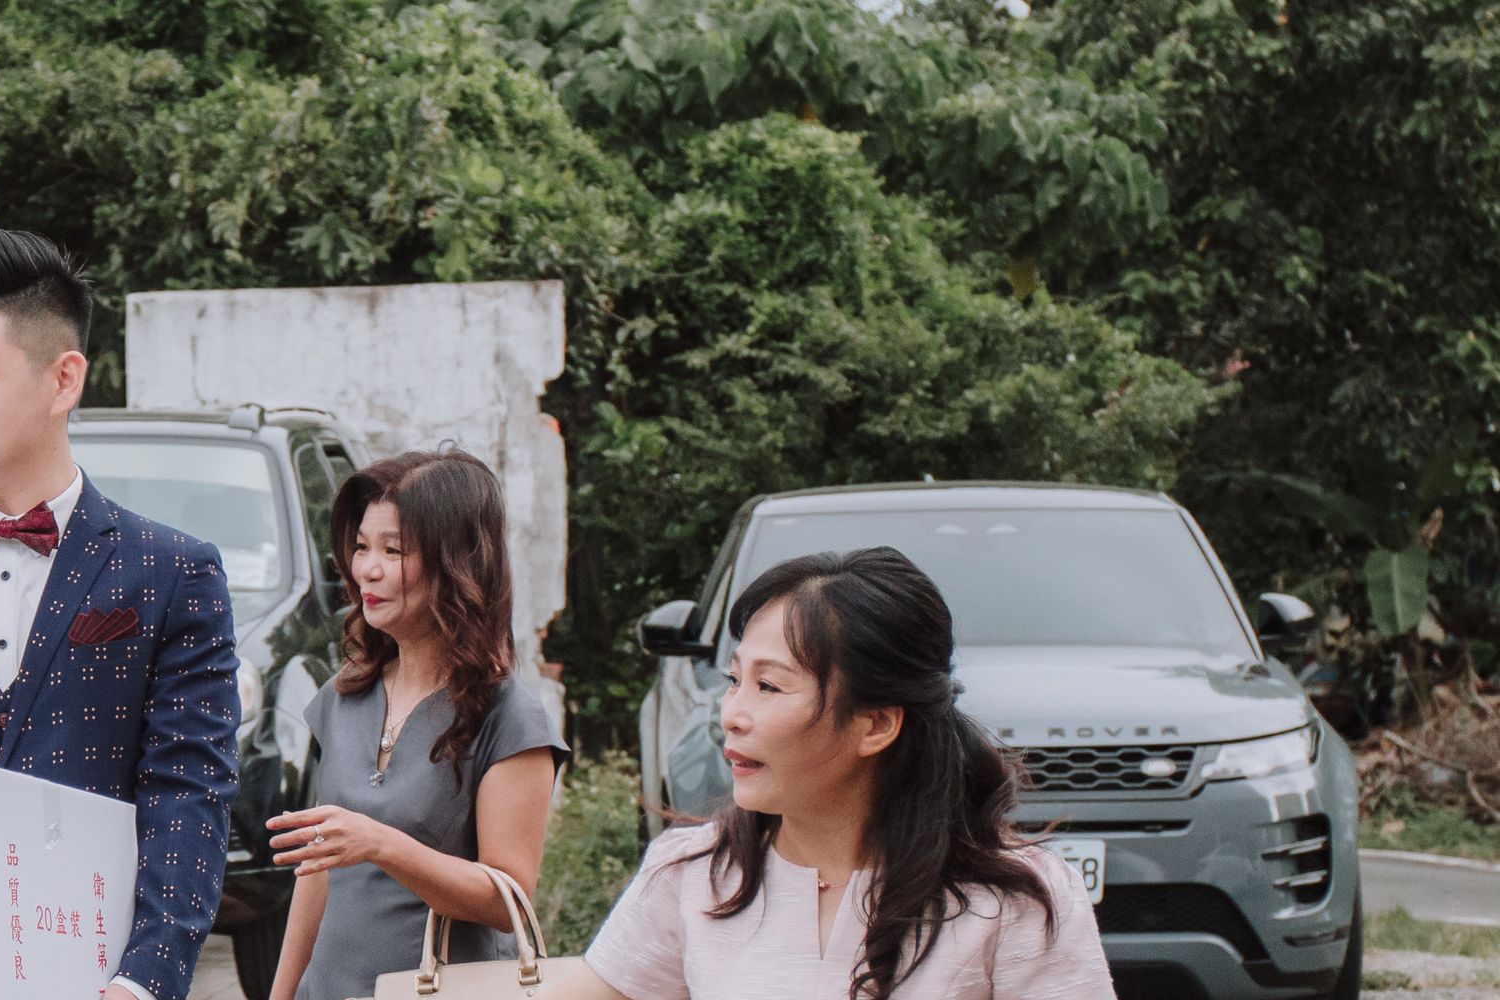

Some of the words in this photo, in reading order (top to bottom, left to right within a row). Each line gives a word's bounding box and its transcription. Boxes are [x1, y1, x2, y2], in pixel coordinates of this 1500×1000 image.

[1048, 726, 1179, 738] ROVER
[6, 842, 26, 980] 品質優良
[36, 905, 83, 938] 20盒裝
